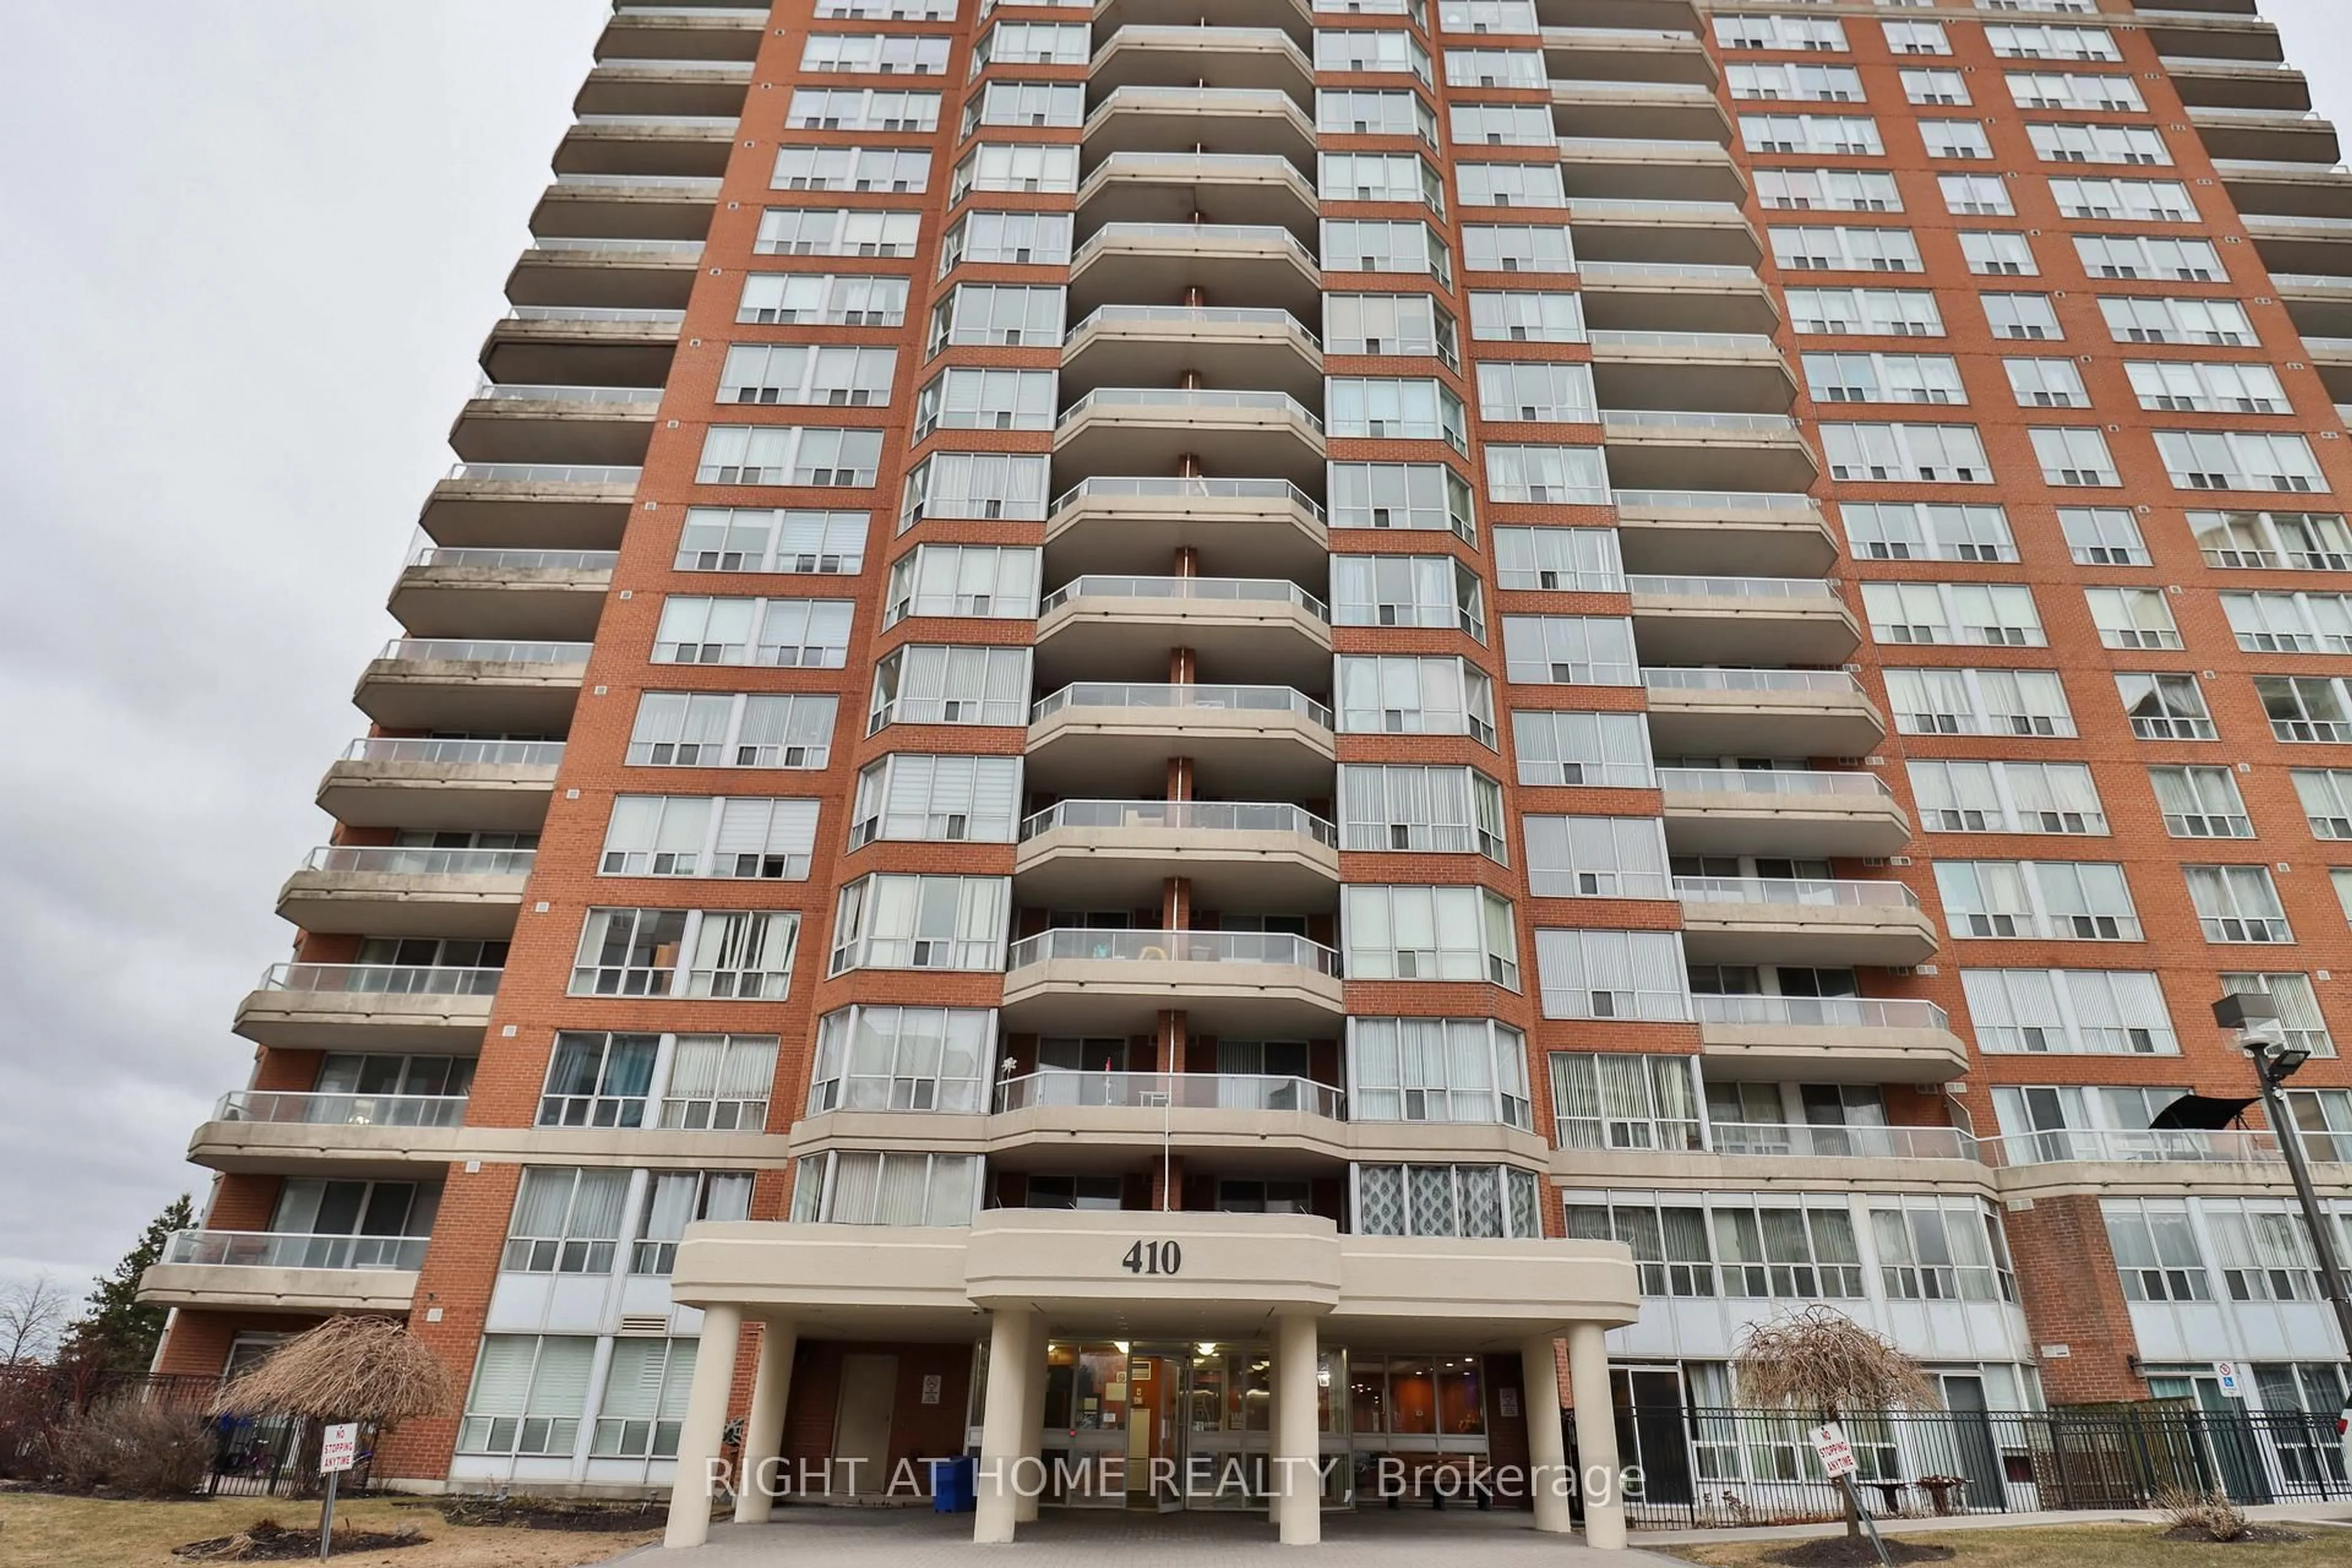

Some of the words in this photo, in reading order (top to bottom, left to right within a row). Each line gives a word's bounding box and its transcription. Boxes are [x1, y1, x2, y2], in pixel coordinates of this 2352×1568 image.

[1122, 1240, 1181, 1275] 410
[336, 1430, 345, 1439] NO
[1821, 1430, 1831, 1441] NO
[324, 1441, 353, 1454] STOPPING
[1819, 1441, 1848, 1458] STOPPING
[324, 1455, 351, 1468] ANYTIME
[1826, 1455, 1853, 1471] ANYTIME
